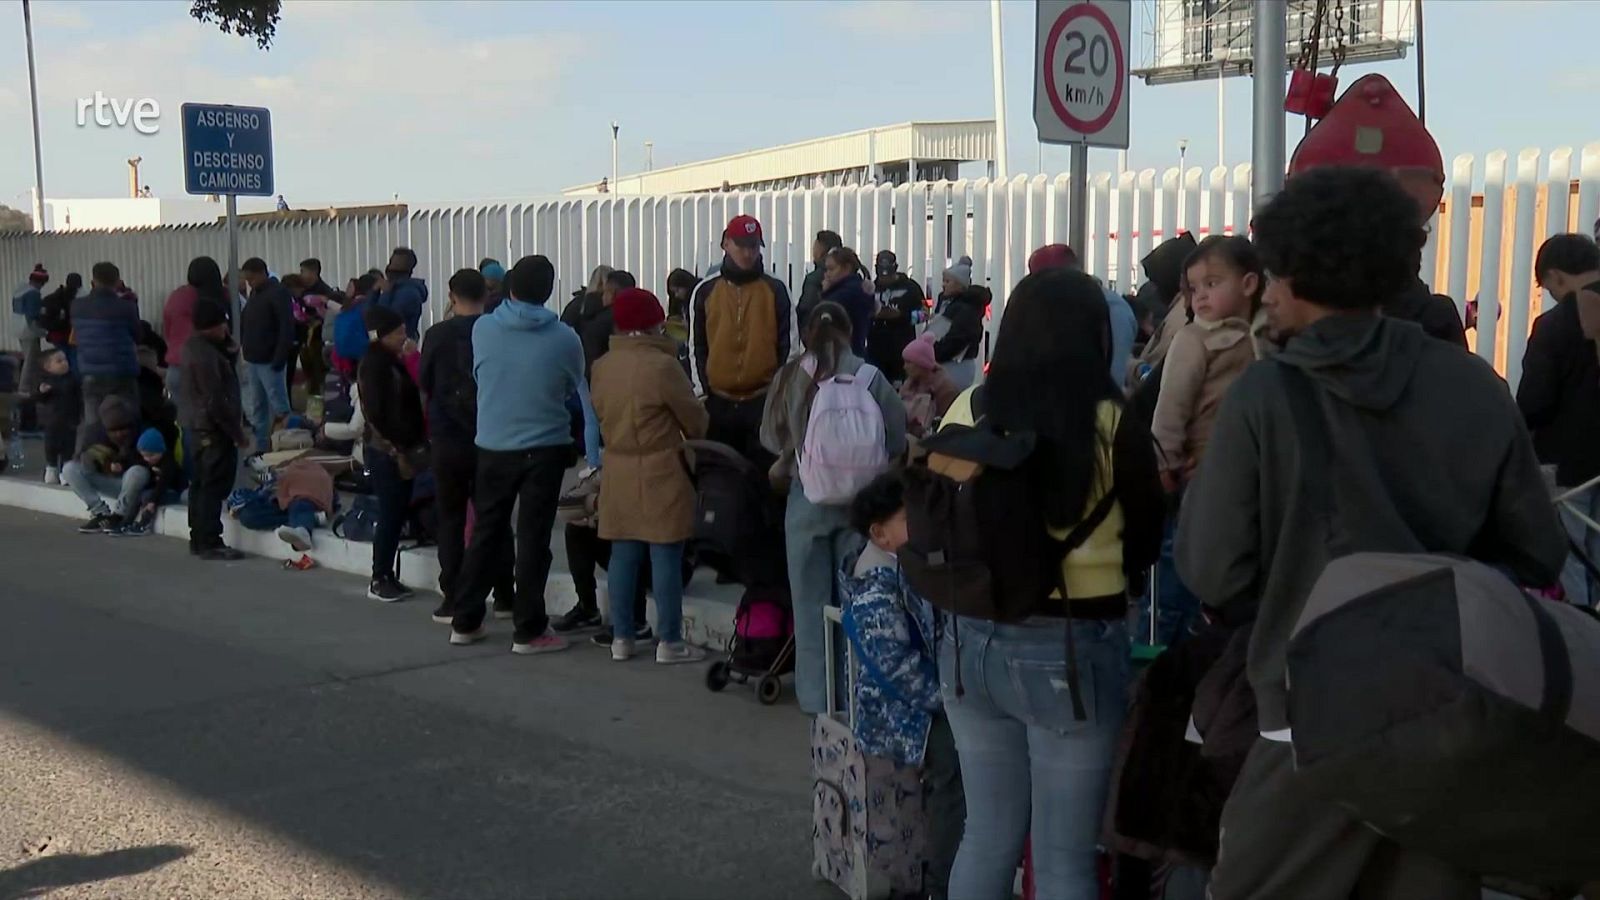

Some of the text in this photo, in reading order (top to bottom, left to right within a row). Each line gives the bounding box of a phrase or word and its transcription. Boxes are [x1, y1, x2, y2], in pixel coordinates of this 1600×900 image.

[1064, 31, 1109, 77] 20
[1065, 83, 1104, 106] km/h
[197, 110, 260, 130] ASCENSO
[226, 132, 236, 149] Y
[193, 151, 264, 170] DESCENSO
[199, 172, 262, 189] CAMIONES
